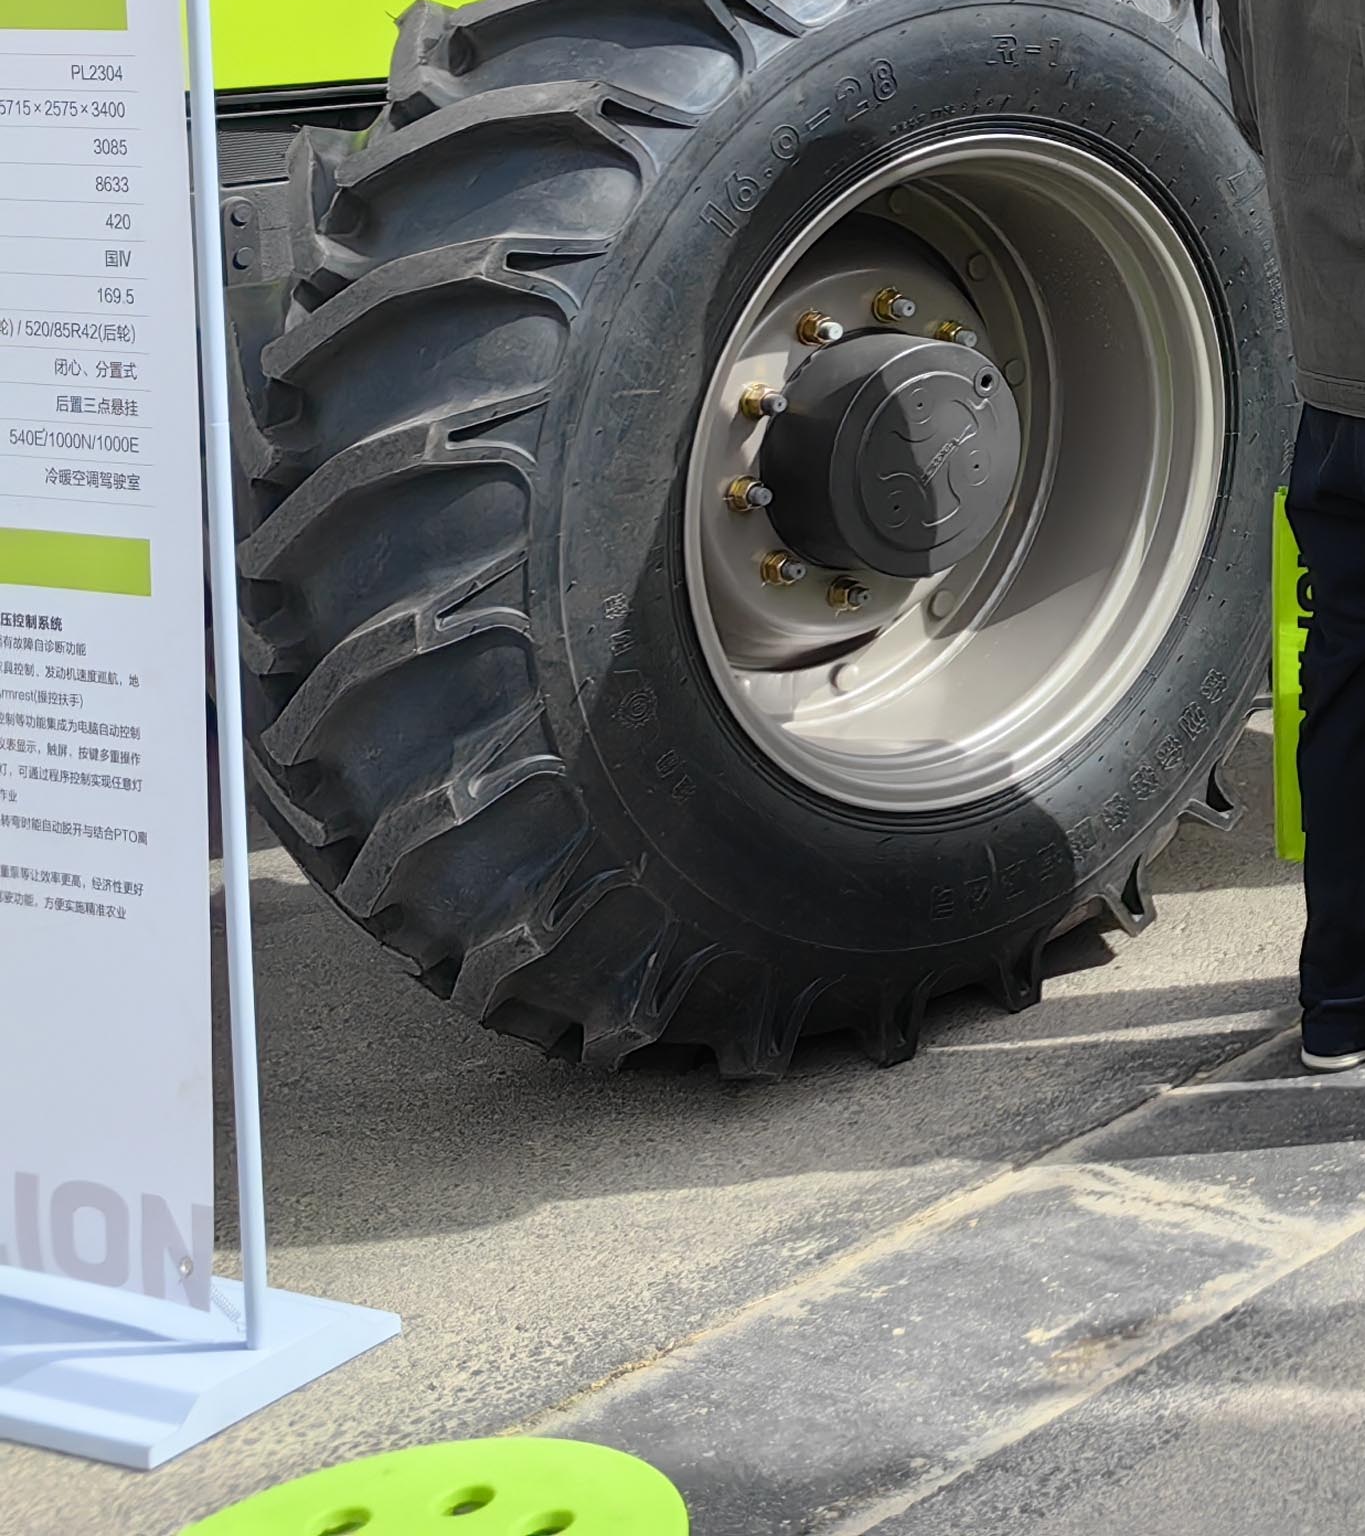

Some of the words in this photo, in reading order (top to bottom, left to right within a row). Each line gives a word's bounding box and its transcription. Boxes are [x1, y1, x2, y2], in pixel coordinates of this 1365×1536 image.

[71, 65, 123, 81] PL2304
[93, 139, 128, 155] 3085
[95, 176, 130, 192] 8633
[105, 213, 131, 230] 420
[97, 288, 135, 305] 169.5
[54, 358, 138, 380] 闭心、分置式
[56, 395, 139, 417] 后置三点悬挂
[45, 467, 141, 491] 冷暖空调驾驶室
[0, 633, 87, 657] 有故障自诊断功能
[0, 1171, 215, 1313] ION
